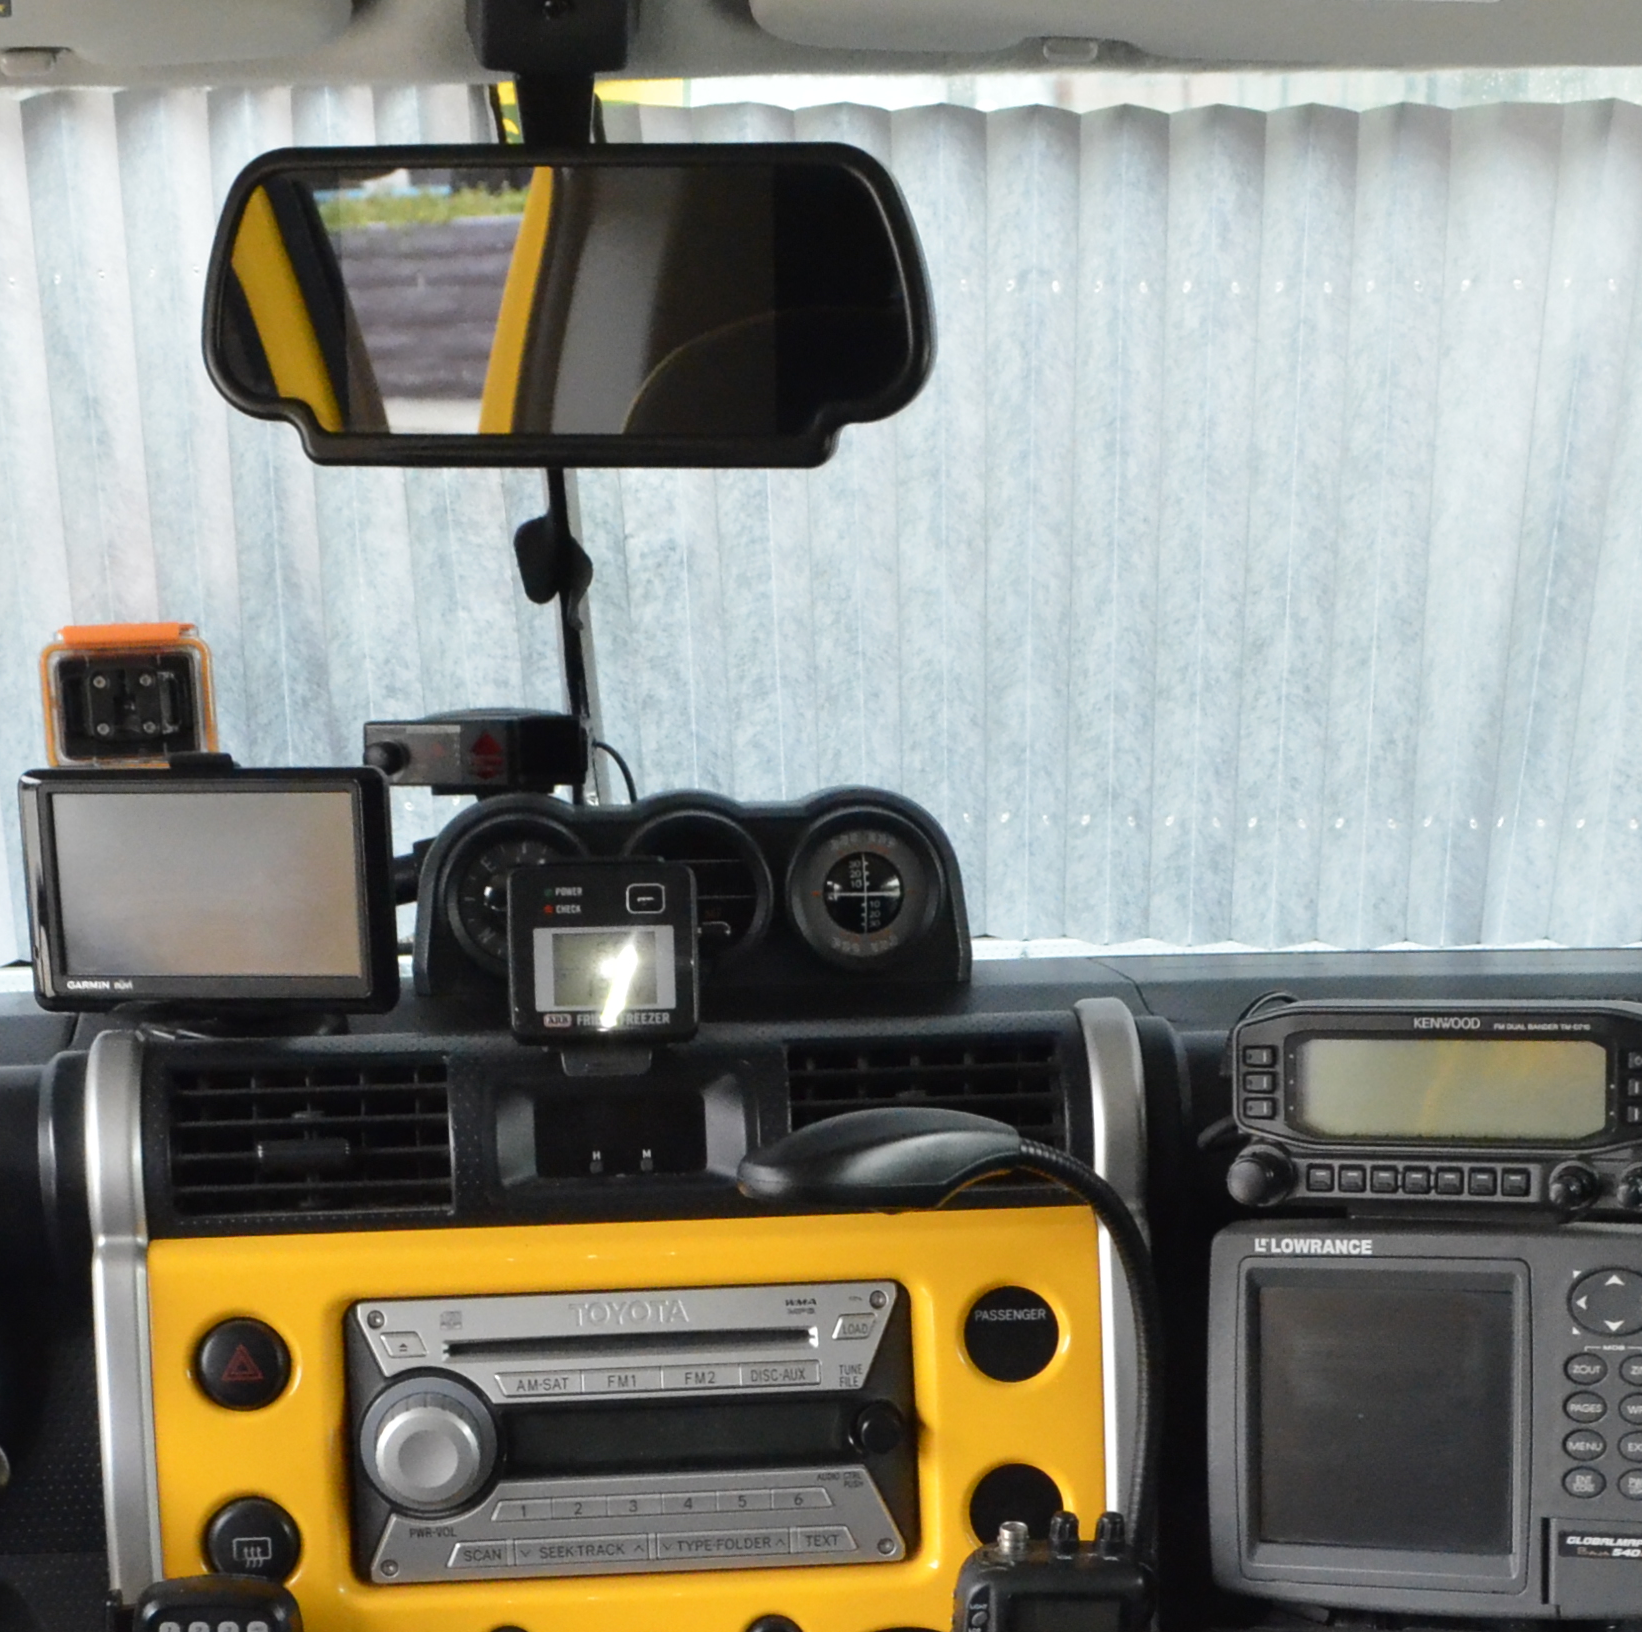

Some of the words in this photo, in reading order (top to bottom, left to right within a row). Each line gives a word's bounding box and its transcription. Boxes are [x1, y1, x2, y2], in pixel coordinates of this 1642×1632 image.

[555, 887, 583, 897] POWER
[555, 904, 582, 914] CHECK
[66, 980, 110, 990] GARMIN
[622, 1011, 670, 1025] FREEZER
[1413, 1017, 1481, 1030] KENWOOD
[592, 1150, 601, 1161] H
[642, 1148, 652, 1159] M
[1270, 1238, 1373, 1255] LOWRANCE
[569, 1299, 690, 1327] TOYOTA
[974, 1308, 1047, 1322] PASSENGER
[842, 1323, 869, 1335] LOAD
[839, 1363, 863, 1376] TUNE
[607, 1374, 637, 1389] FM1
[684, 1371, 716, 1386] FM2
[839, 1376, 859, 1388] FILE
[1569, 1403, 1603, 1413] PAGES
[1567, 1442, 1603, 1451] MENU
[629, 1500, 638, 1513] 3
[683, 1497, 693, 1510] 4
[738, 1496, 747, 1508] 5
[794, 1494, 804, 1506] 6
[573, 1502, 583, 1516] 2
[806, 1533, 840, 1548] TEXT
[464, 1548, 502, 1563] SCAN
